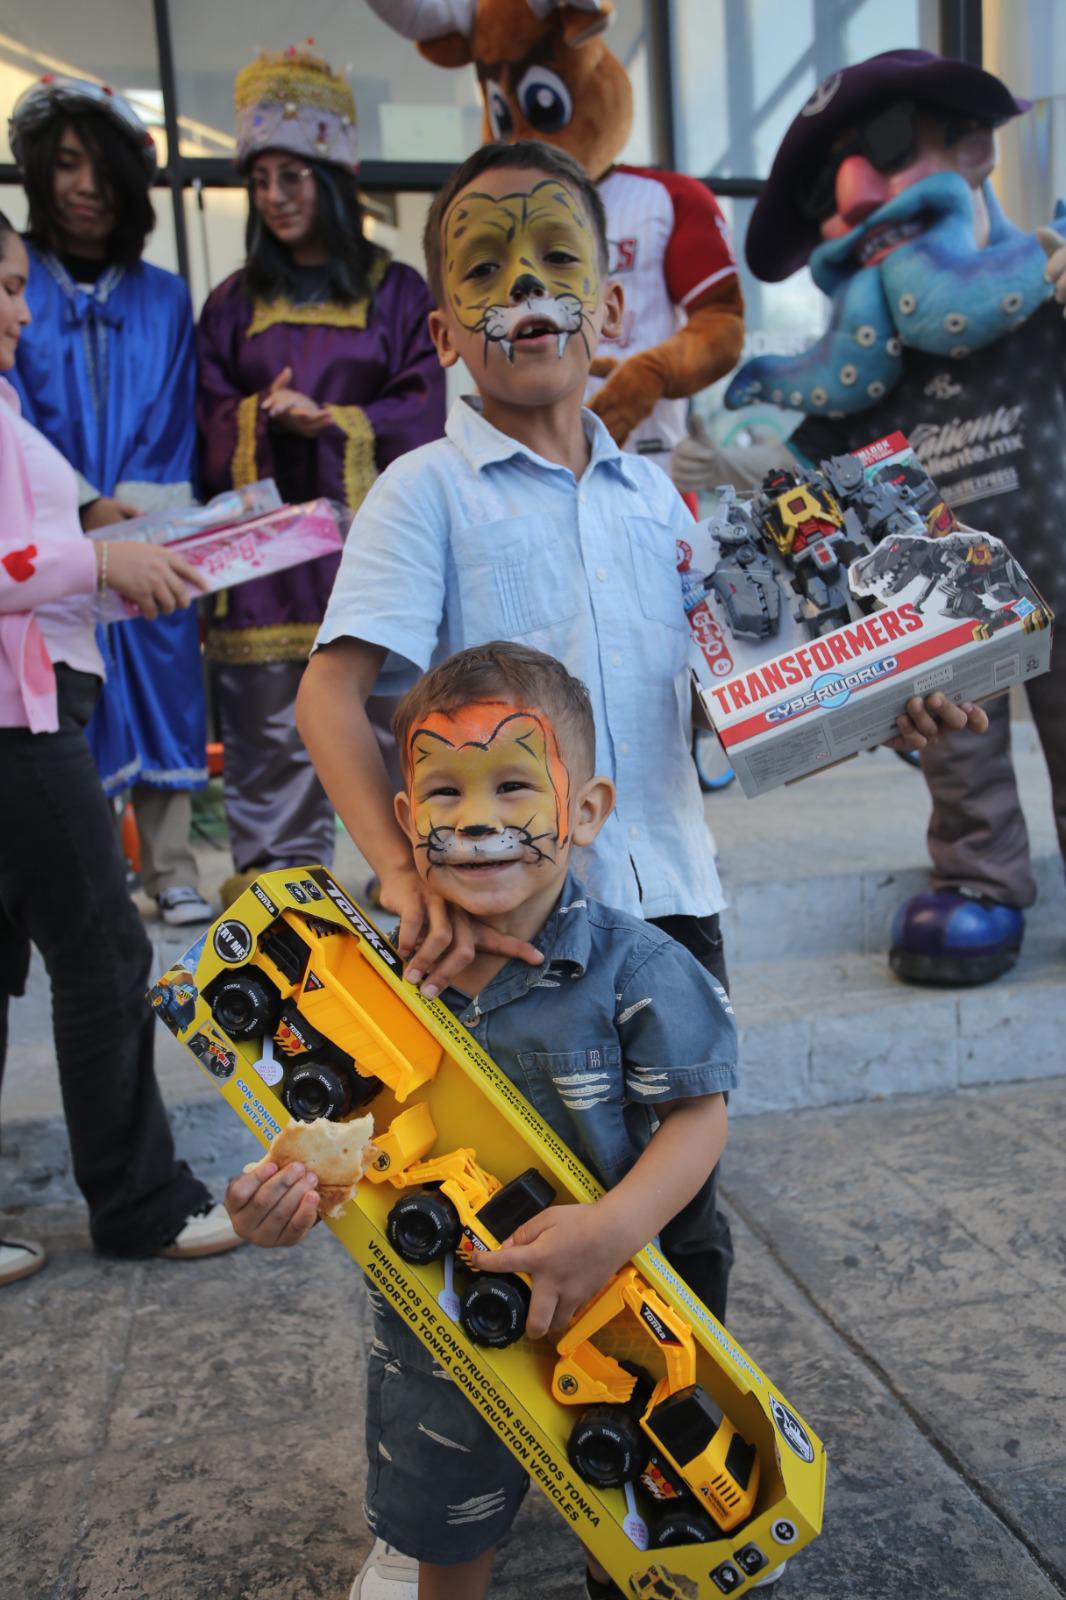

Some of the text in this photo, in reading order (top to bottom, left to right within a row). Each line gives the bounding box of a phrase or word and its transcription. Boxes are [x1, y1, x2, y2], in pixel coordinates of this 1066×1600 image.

[711, 602, 924, 715] TRANSFORMERS
[764, 655, 898, 723] CYBERWORLD
[253, 885, 276, 914] Tonka
[325, 879, 397, 966] Tonka
[217, 922, 249, 961] TRY ME!
[223, 983, 241, 991] TONKA
[288, 1022, 306, 1045] Tonka
[292, 1071, 311, 1082] TONKA
[414, 991, 461, 1044] ASSORTED
[463, 1045, 493, 1081] TONKA
[494, 1081, 565, 1163] CONSTRUCTION
[235, 1078, 254, 1101] CON
[252, 1099, 283, 1136] SONIDO
[242, 1101, 264, 1128] WITH
[460, 1036, 474, 1048] DE
[474, 1051, 544, 1131] CONSTRUCCION
[545, 1132, 591, 1184] SURTIDOS
[400, 1204, 418, 1214] TONKA
[466, 1290, 479, 1308] TONKA
[490, 1287, 509, 1302] TONKA
[643, 1306, 667, 1340] Tonka
[366, 1262, 580, 1522] ASSORTED TONKA CONSTRUCTION VEHICLES
[367, 1240, 601, 1528] VEHICULOS DE CONSTRUCCION SURTIDOS TONKA
[602, 1428, 621, 1443] TONKA
[777, 1525, 792, 1538] 3+
